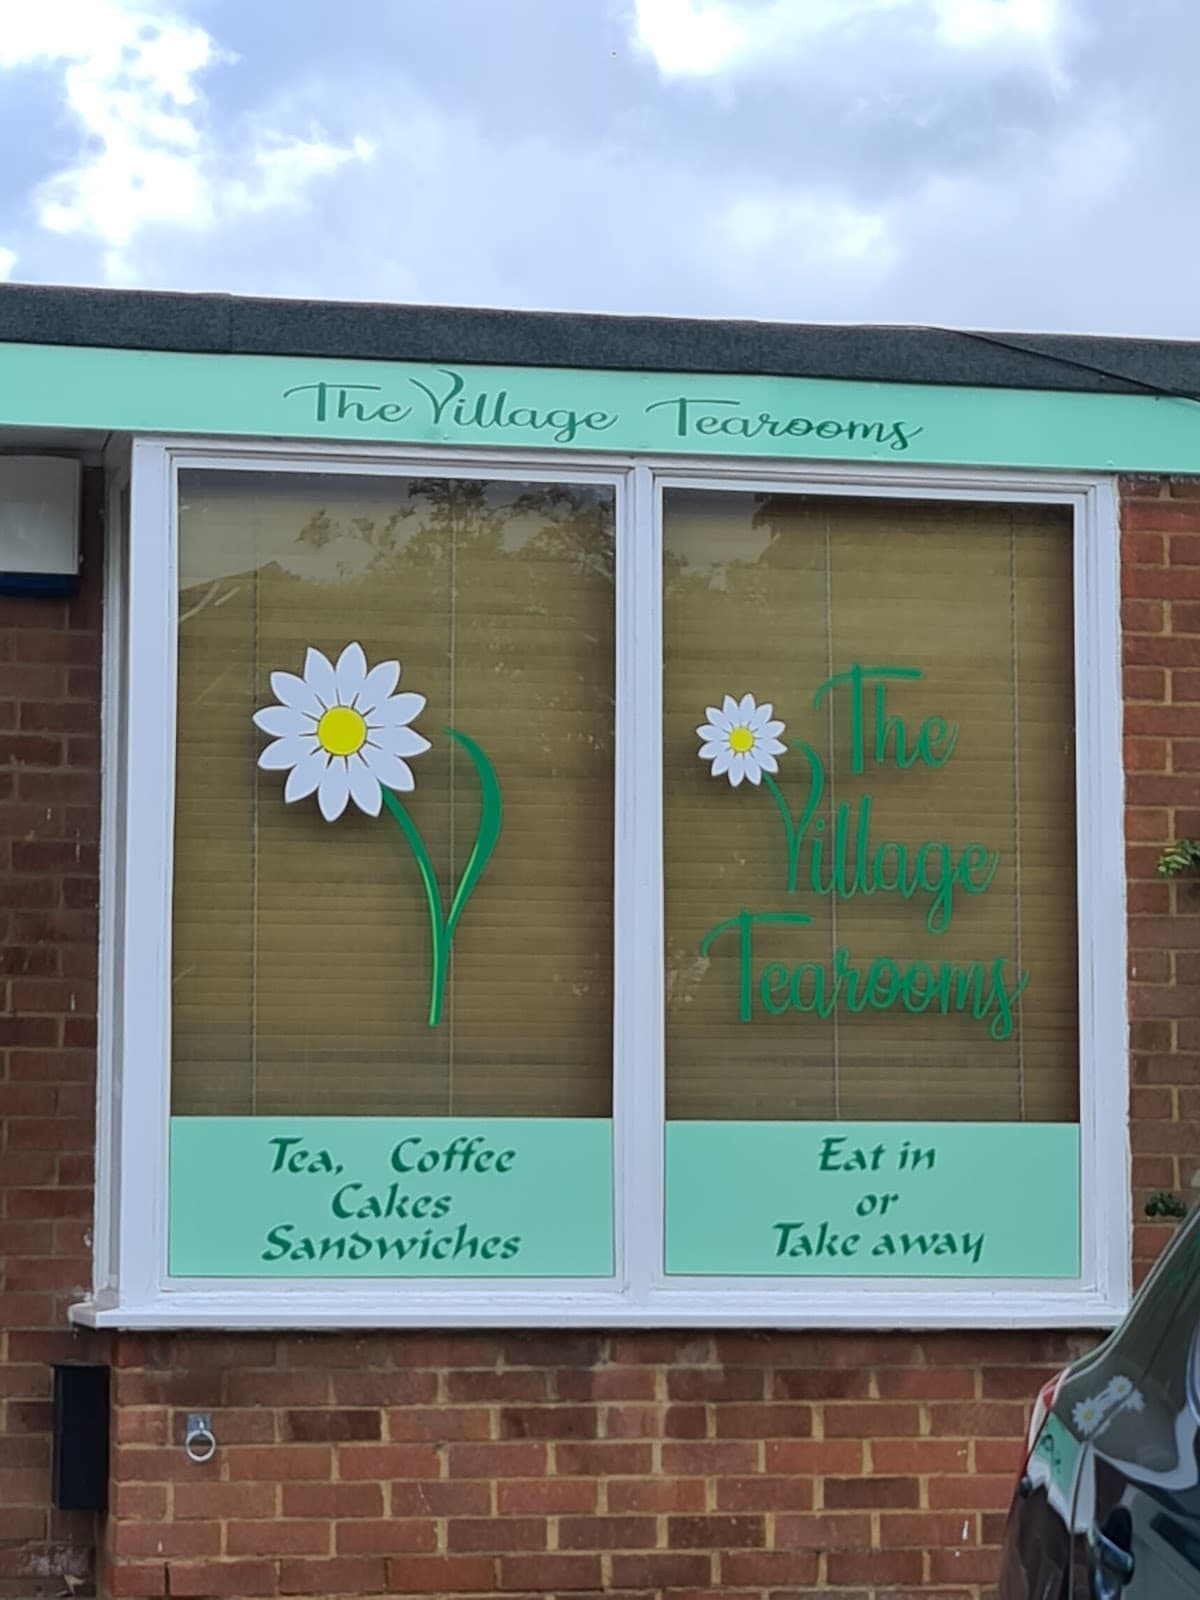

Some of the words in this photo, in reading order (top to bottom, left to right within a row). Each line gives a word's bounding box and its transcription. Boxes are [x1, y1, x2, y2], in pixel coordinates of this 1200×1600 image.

[283, 382, 412, 422] The
[409, 369, 618, 443] Village
[645, 397, 923, 450] Tearooms
[813, 662, 959, 775] The
[762, 737, 999, 935] Village
[700, 908, 1030, 1040] Tearooms
[269, 1137, 343, 1175] Tea,
[391, 1136, 516, 1173] Coffee
[819, 1136, 885, 1171] Eat
[898, 1141, 936, 1171] in
[331, 1182, 453, 1219] Cakes
[856, 1193, 899, 1216] or
[262, 1223, 521, 1261] Sandwiches
[772, 1221, 860, 1257] Take
[871, 1232, 984, 1263] away
